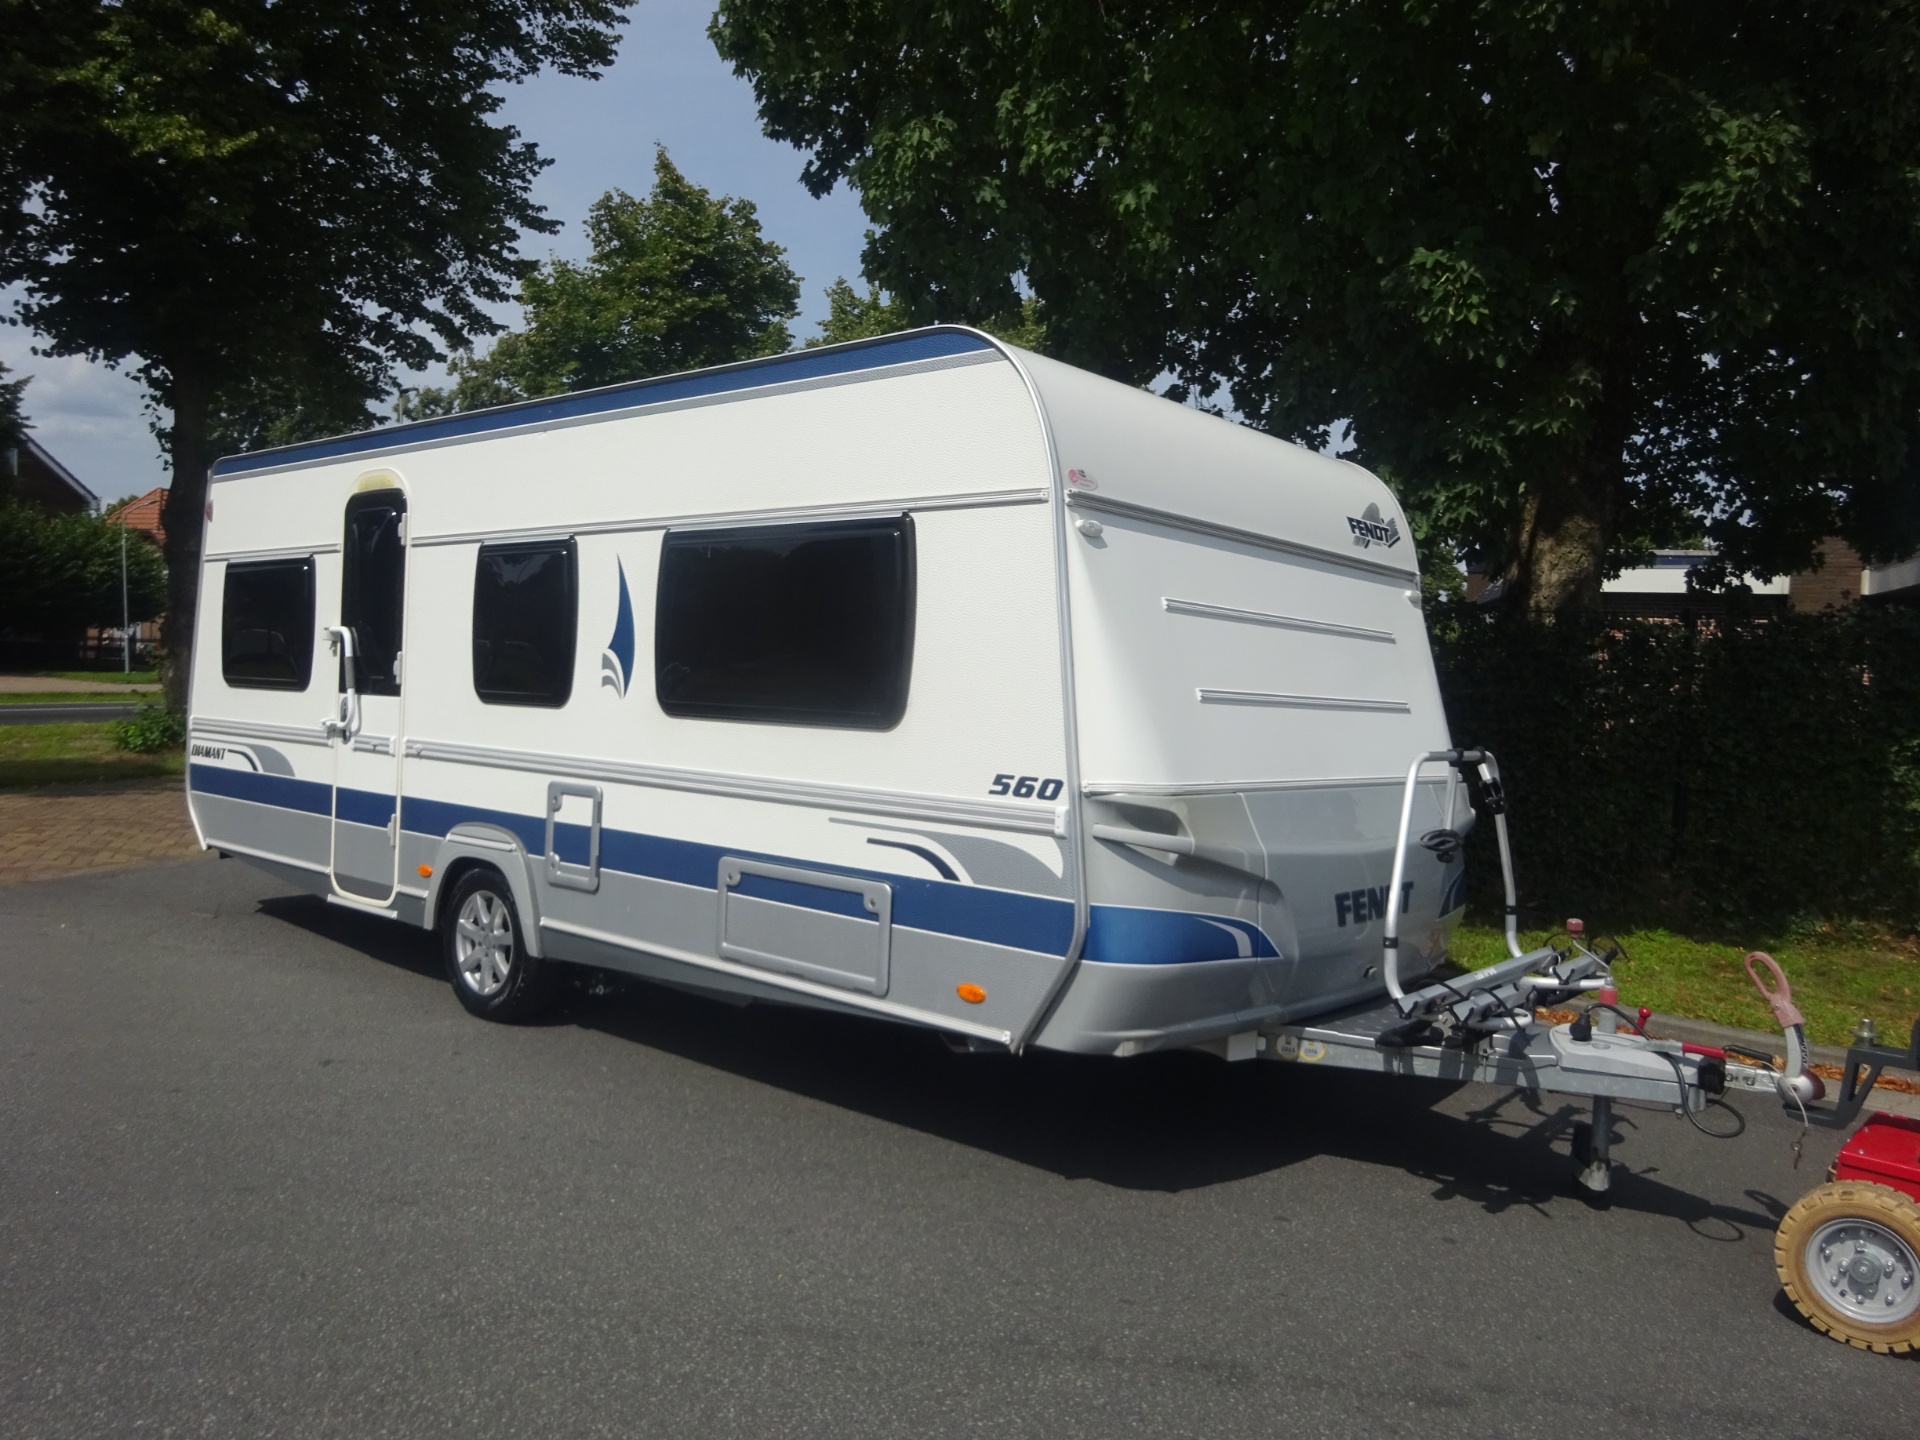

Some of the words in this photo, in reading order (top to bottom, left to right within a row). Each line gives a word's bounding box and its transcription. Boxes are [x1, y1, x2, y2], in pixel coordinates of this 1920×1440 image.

[1346, 515, 1390, 543] FENDT
[191, 744, 227, 760] DIAMANT
[988, 773, 1064, 801] 560
[1334, 881, 1414, 927] FENT
